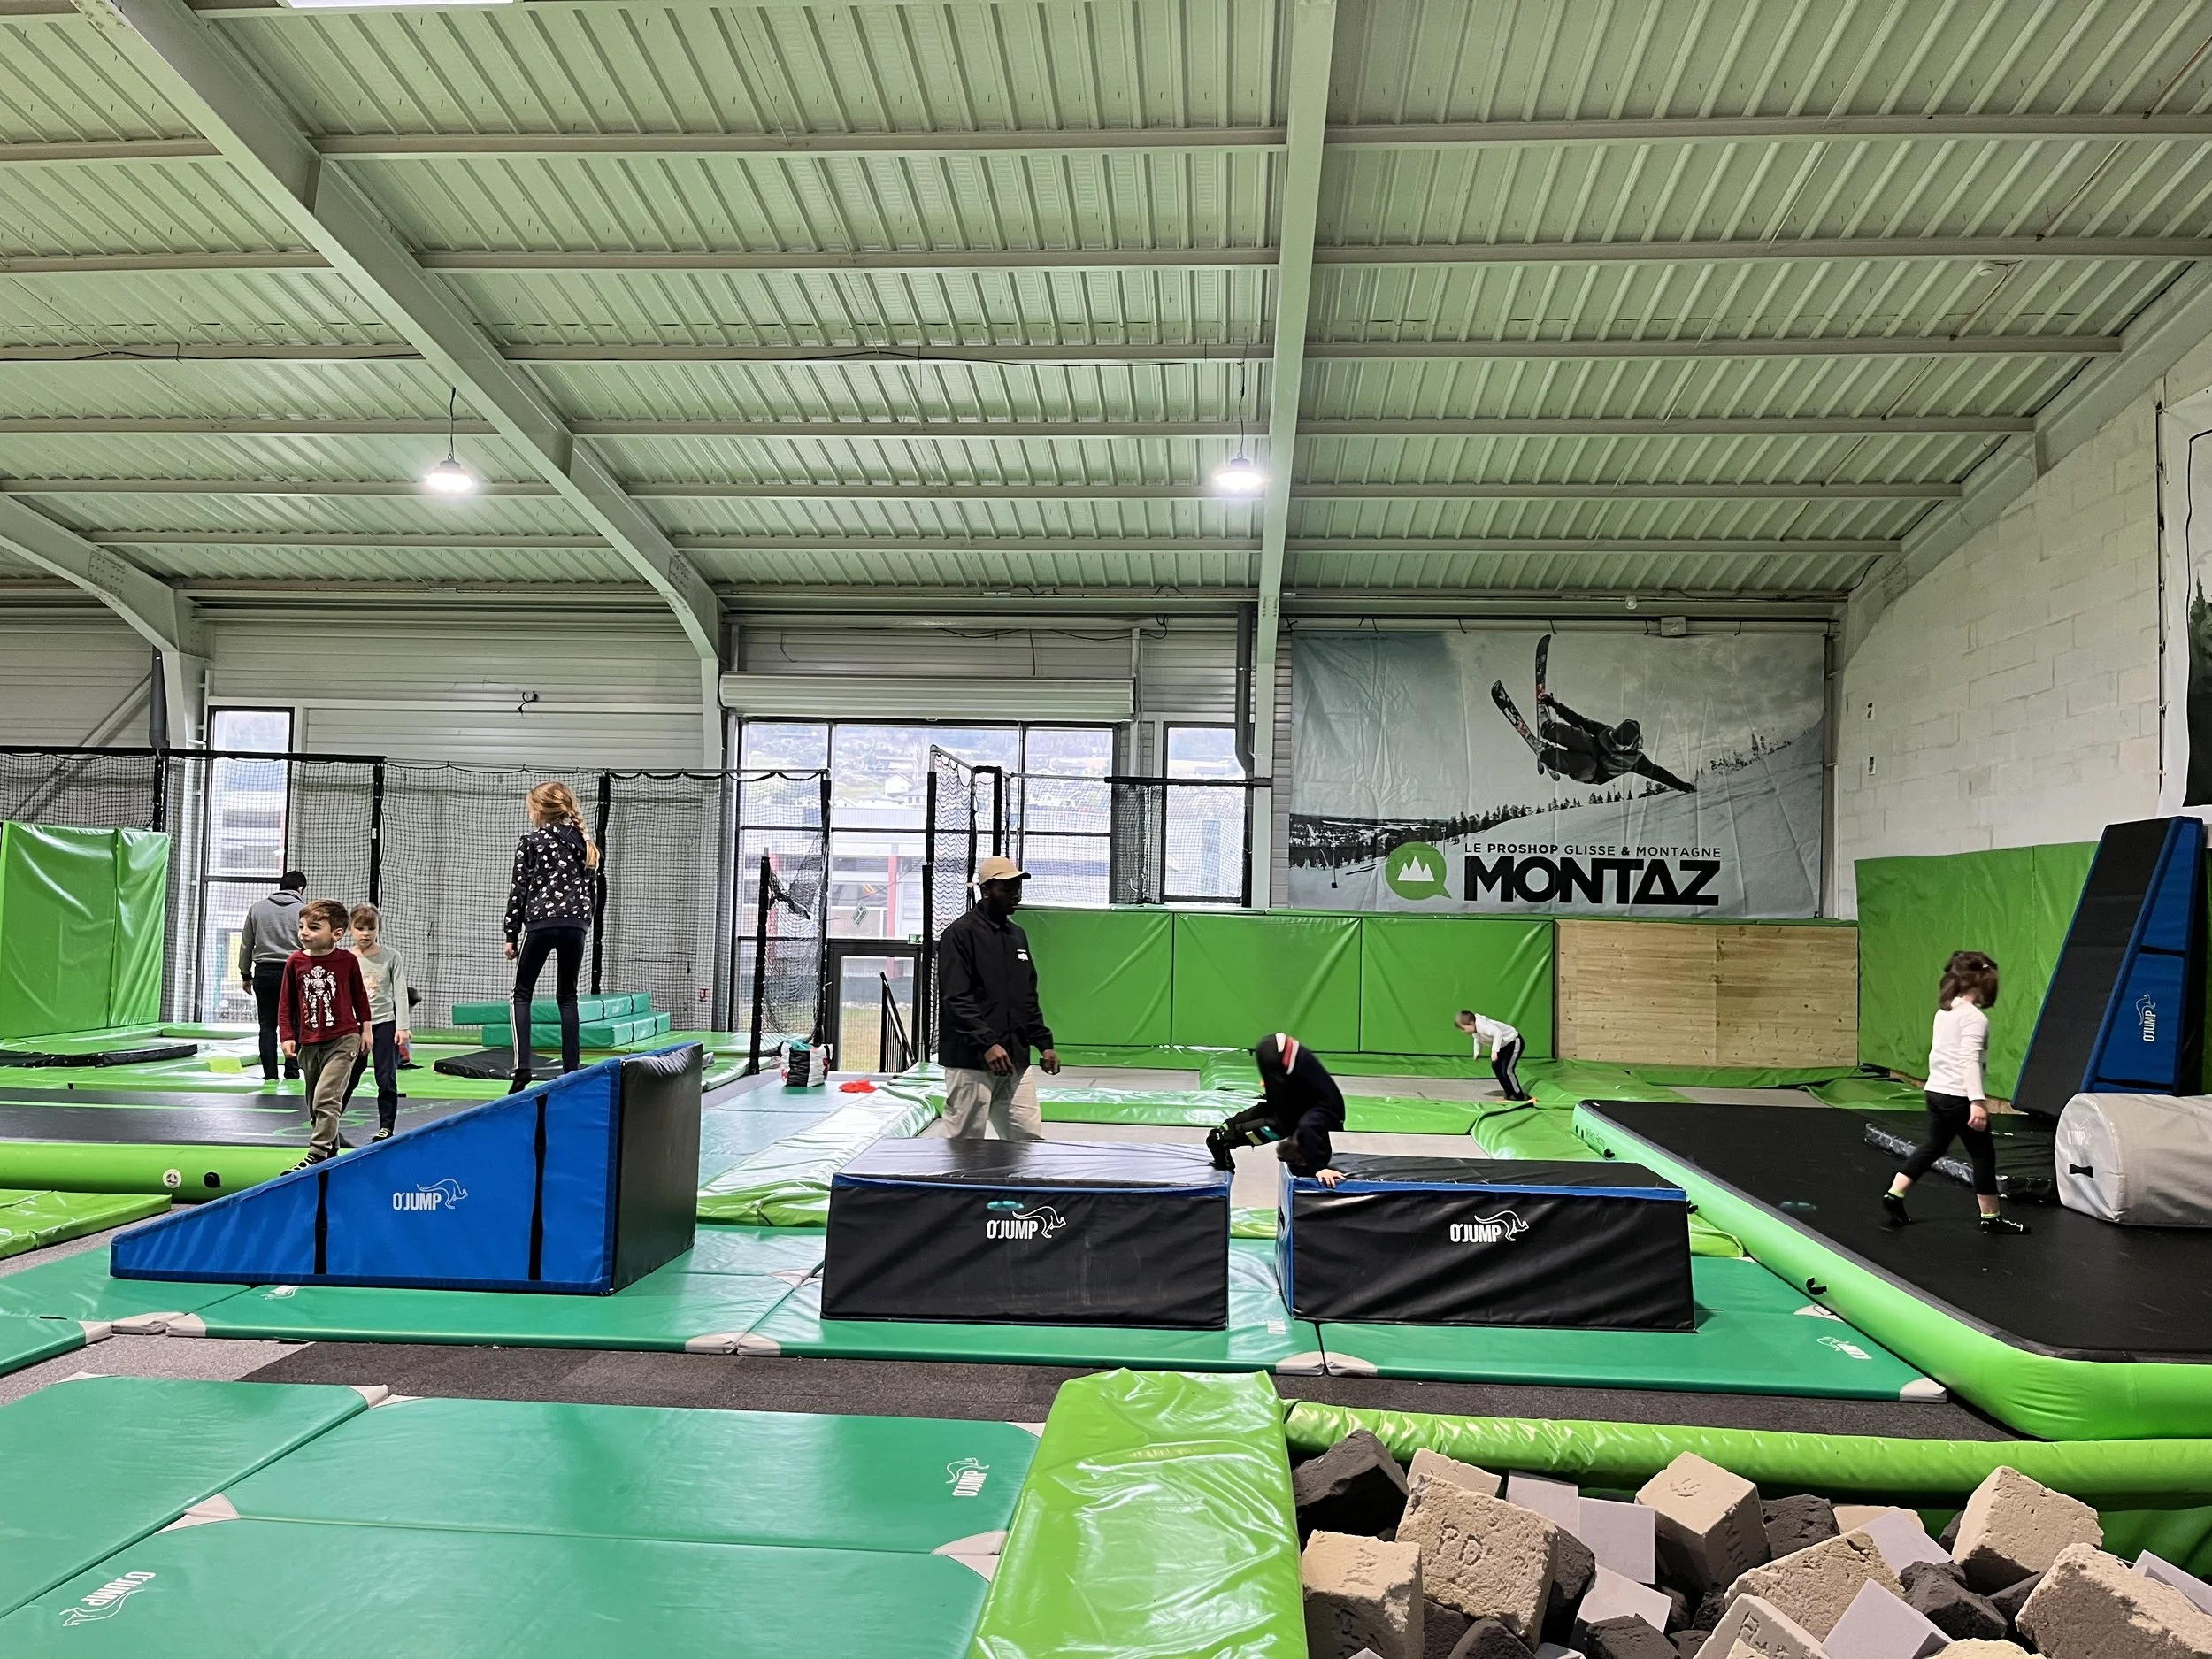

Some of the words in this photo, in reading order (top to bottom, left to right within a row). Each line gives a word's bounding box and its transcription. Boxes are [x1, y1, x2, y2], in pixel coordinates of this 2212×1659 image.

[1464, 843, 1481, 853] LE
[1487, 844, 1558, 854] PROSHOP
[1564, 845, 1615, 856] GLISSE
[1621, 846, 1630, 856] &
[1637, 847, 1721, 857] MONTAGNE
[1464, 856, 1720, 906] MONTAZ
[392, 1192, 442, 1210] O'JUMP
[987, 1219, 1038, 1239] O'JUMP
[1450, 1223, 1502, 1243] O'JUMP
